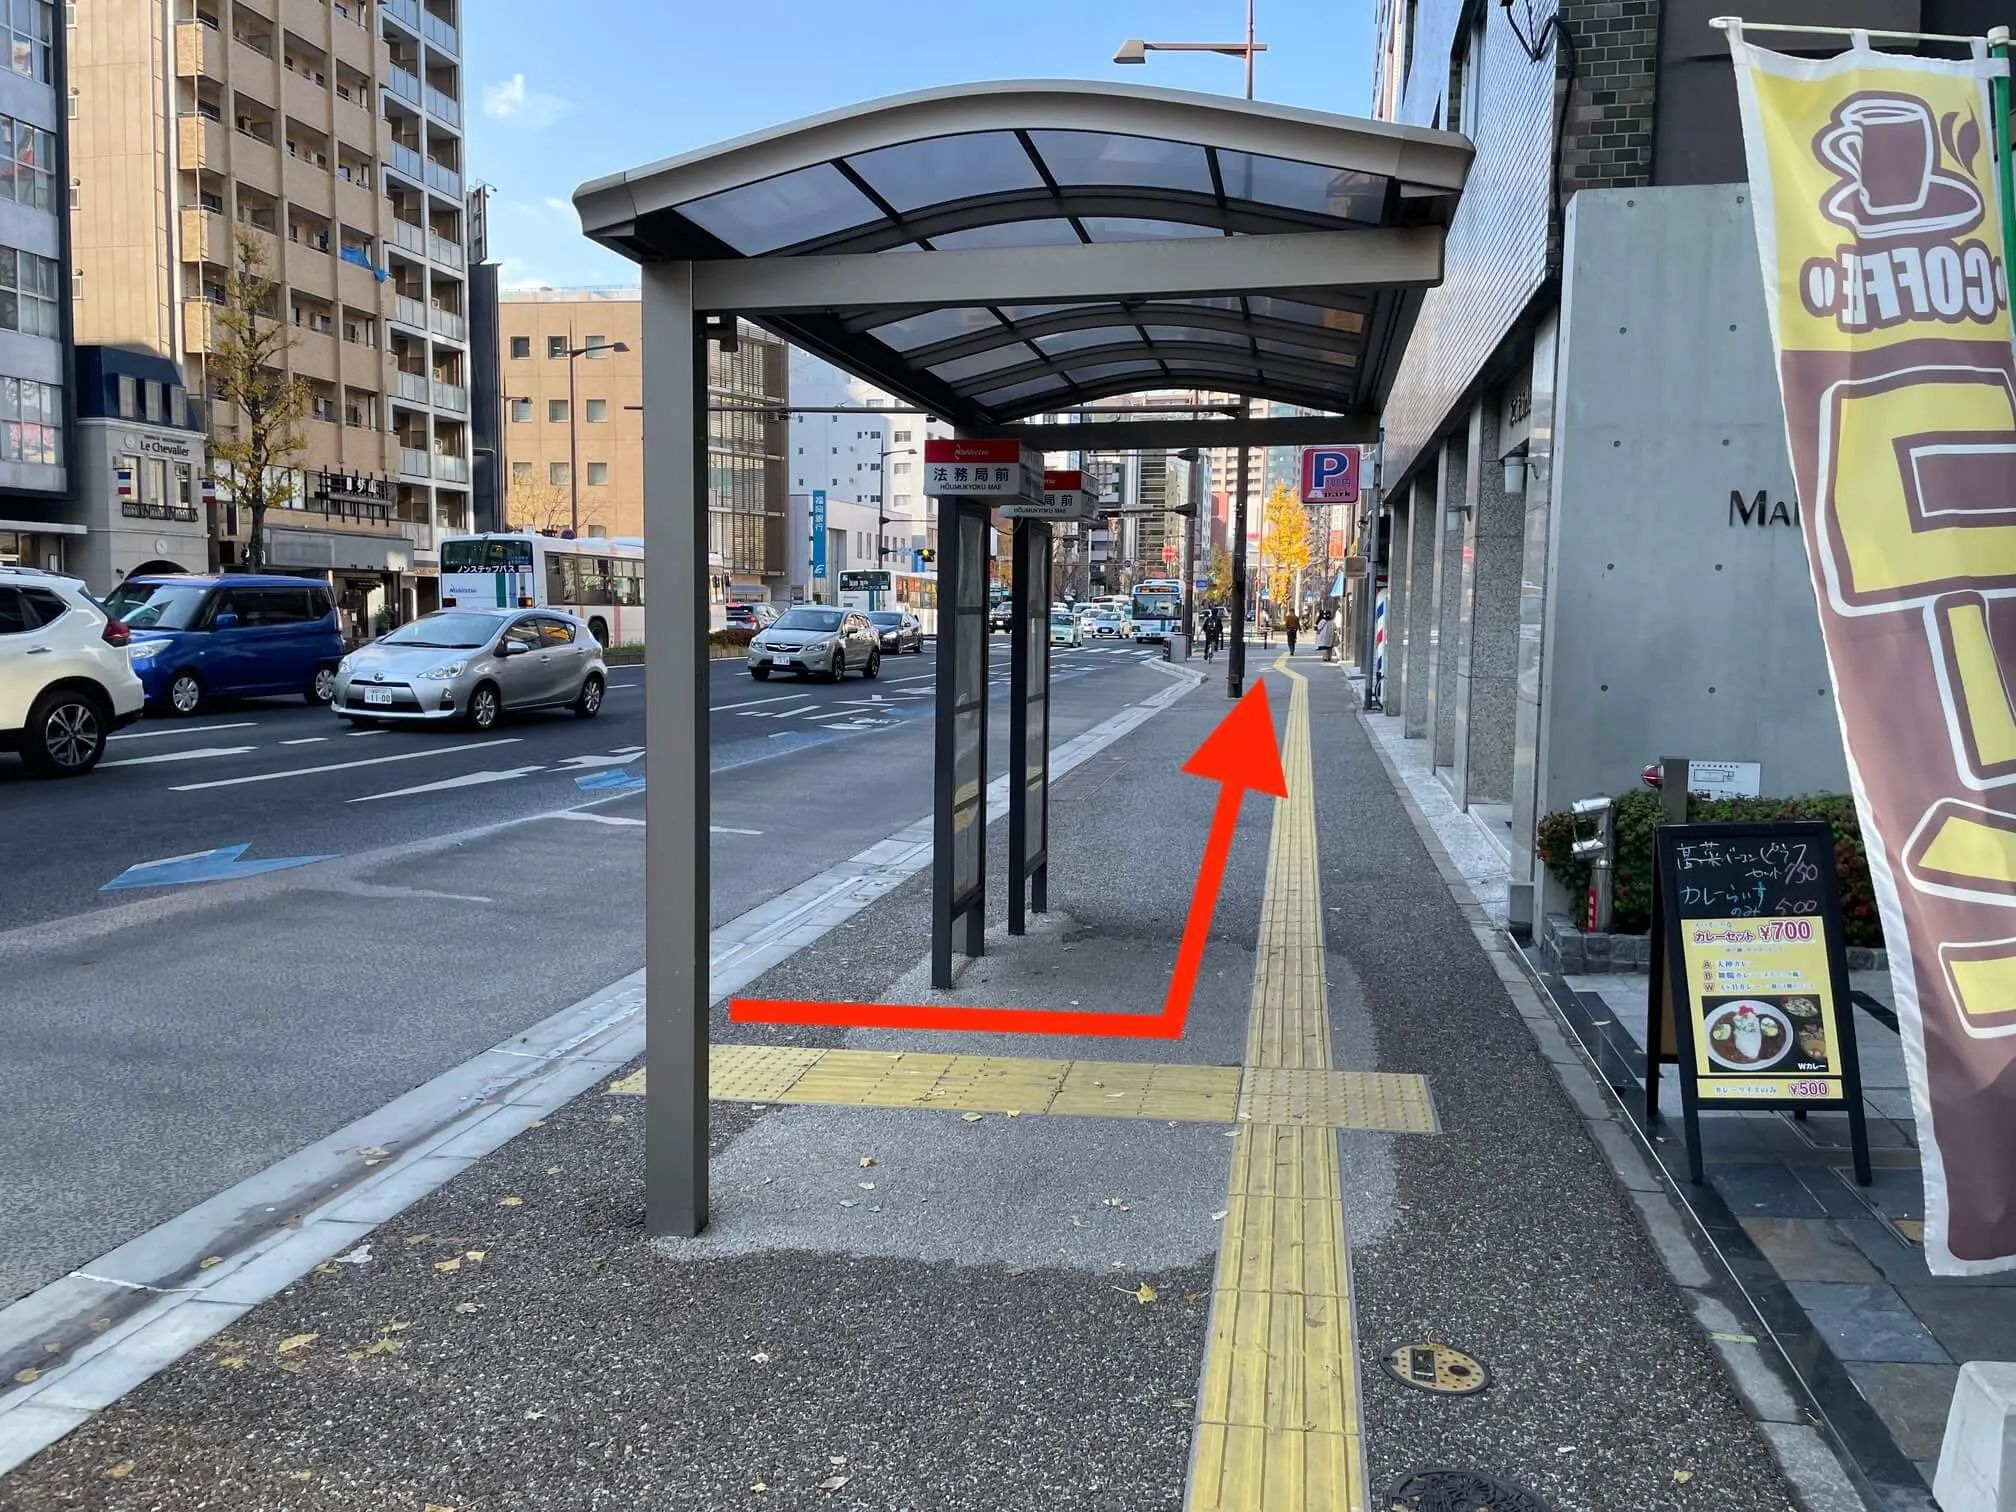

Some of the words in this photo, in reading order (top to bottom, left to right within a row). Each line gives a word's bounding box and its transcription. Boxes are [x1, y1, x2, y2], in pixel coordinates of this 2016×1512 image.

[140, 440, 150, 451] Le
[152, 442, 189, 457] Chevalier
[934, 467, 1009, 482] 法務局前
[1312, 451, 1349, 489] P
[815, 496, 824, 531] 福岡銀行
[457, 564, 516, 573] ノンステップバス
[1694, 930, 1755, 943] カレーセット
[1759, 919, 1814, 942] ¥700
[1798, 1062, 1827, 1071] Wカレー
